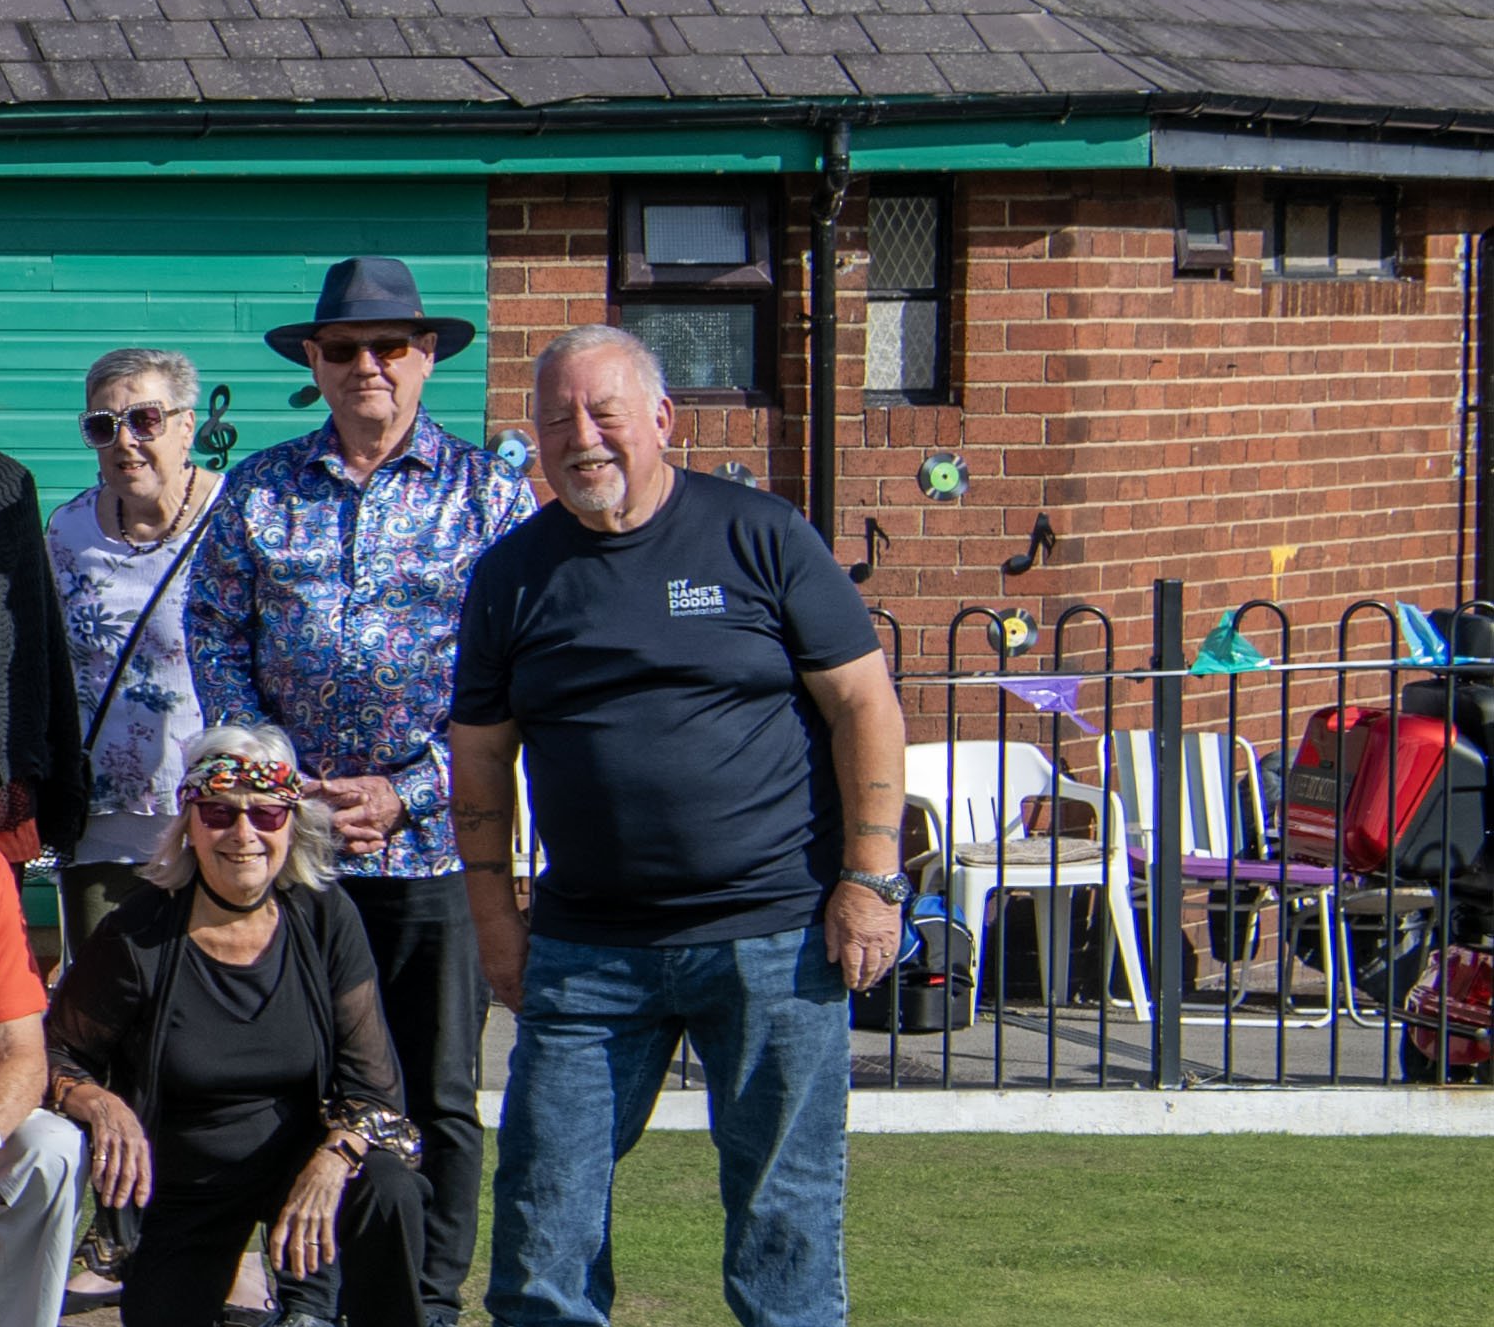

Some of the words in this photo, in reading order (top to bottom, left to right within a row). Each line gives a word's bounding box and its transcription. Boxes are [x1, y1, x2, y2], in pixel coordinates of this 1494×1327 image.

[667, 579, 689, 590] MY
[668, 585, 722, 600] NAME'S
[669, 595, 724, 609] DODDIE
